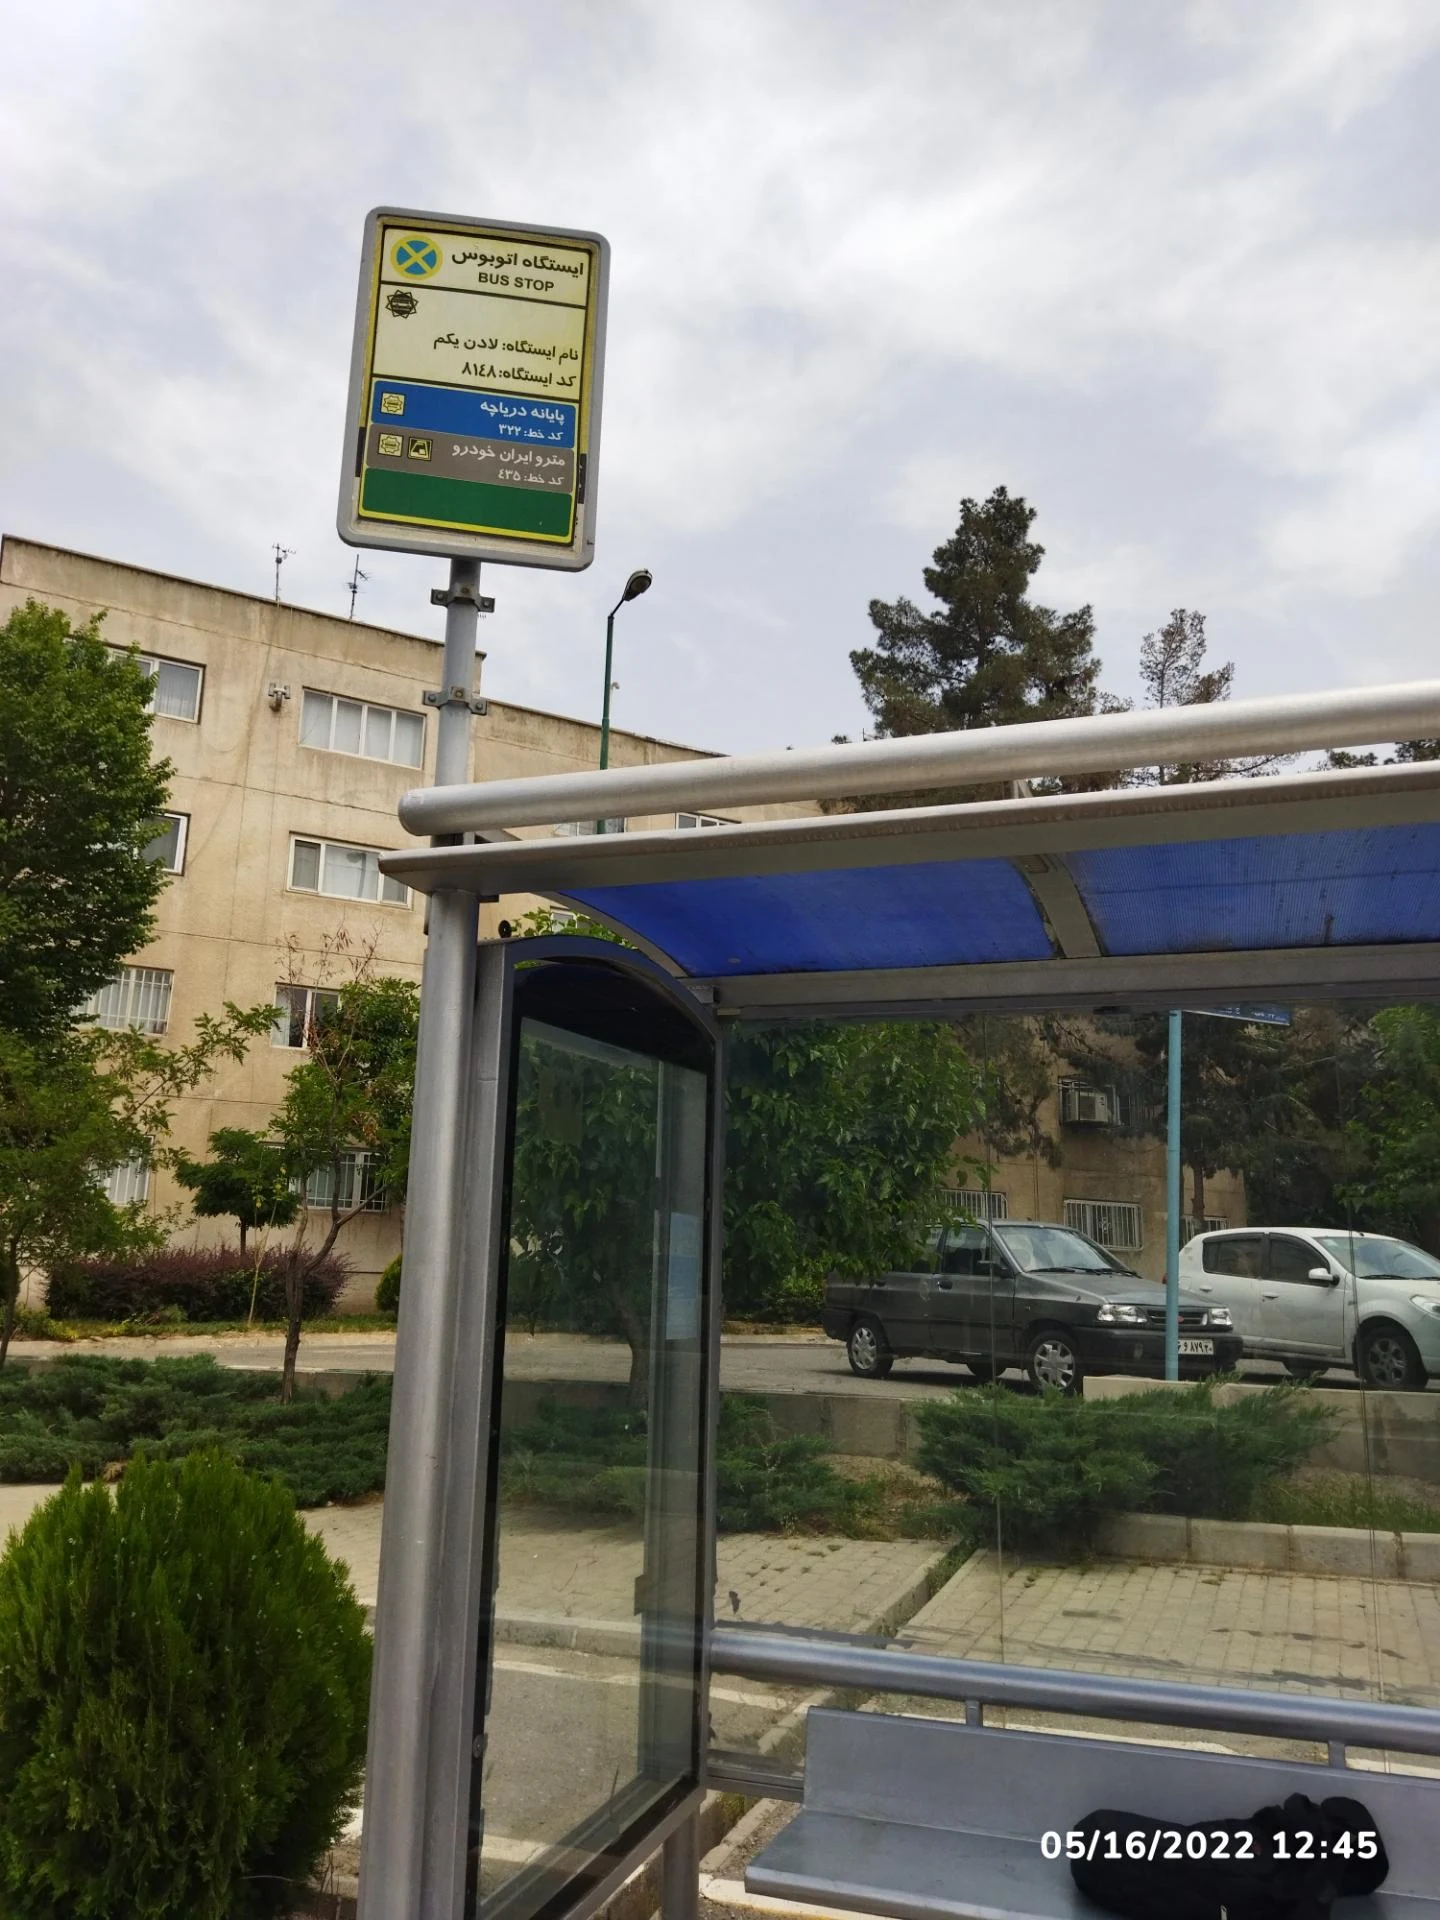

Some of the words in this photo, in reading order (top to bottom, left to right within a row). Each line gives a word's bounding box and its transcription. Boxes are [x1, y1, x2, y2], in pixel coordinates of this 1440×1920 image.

[451, 250, 518, 269] اتوبوس
[522, 255, 584, 278] ایستگاه
[478, 272, 509, 286] BUS
[514, 277, 555, 292] STOP
[433, 333, 460, 350] یکم
[463, 337, 498, 350] لادن
[502, 340, 556, 360] ایستگاه:
[558, 348, 579, 365] نام
[556, 375, 577, 387] کد
[480, 401, 527, 417] دریاچه
[531, 408, 565, 426] پایانه
[523, 428, 545, 439] خط:
[548, 432, 564, 440] کد
[452, 444, 496, 461] خودرو
[500, 448, 533, 465] ایران
[535, 454, 565, 467] مترو
[523, 473, 545, 484] خط:
[548, 477, 565, 485] کد
